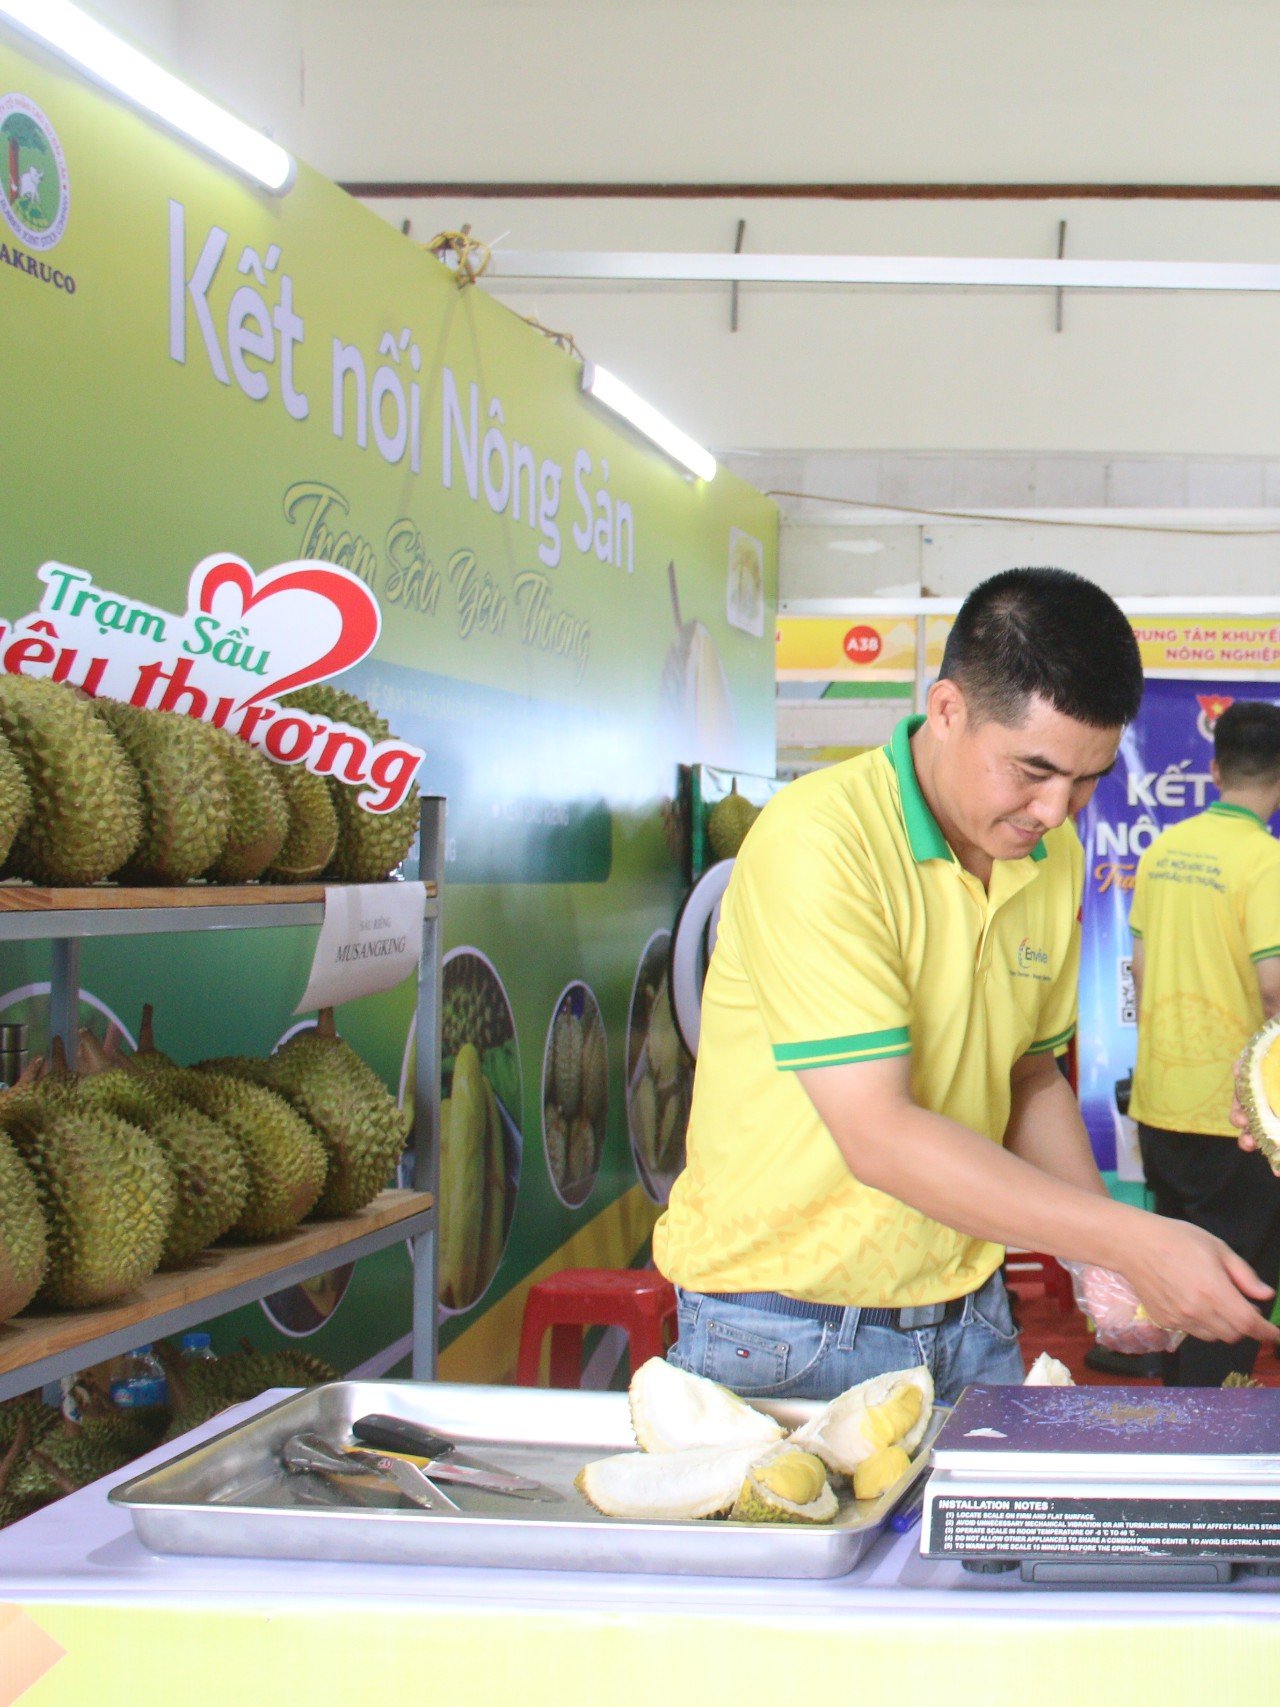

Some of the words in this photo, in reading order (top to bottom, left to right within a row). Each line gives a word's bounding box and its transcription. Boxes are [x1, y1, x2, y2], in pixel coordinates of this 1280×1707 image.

[169, 198, 309, 421] Kết
[331, 327, 421, 474] nối
[442, 367, 561, 568] Nông
[573, 447, 635, 574] Sản
[51, 569, 167, 644] Trạm
[183, 616, 272, 676] Sầu
[1135, 629, 1177, 642] RUNG
[1183, 627, 1217, 642] TÂM
[0, 620, 109, 699] êu
[847, 636, 879, 652] A38
[1166, 646, 1215, 661] NÔNG
[1127, 759, 1212, 808] KẾT
[1096, 815, 1166, 857] NÔ
[939, 1500, 1010, 1510] INSTALLATION
[1014, 1501, 1048, 1511] NOTES
